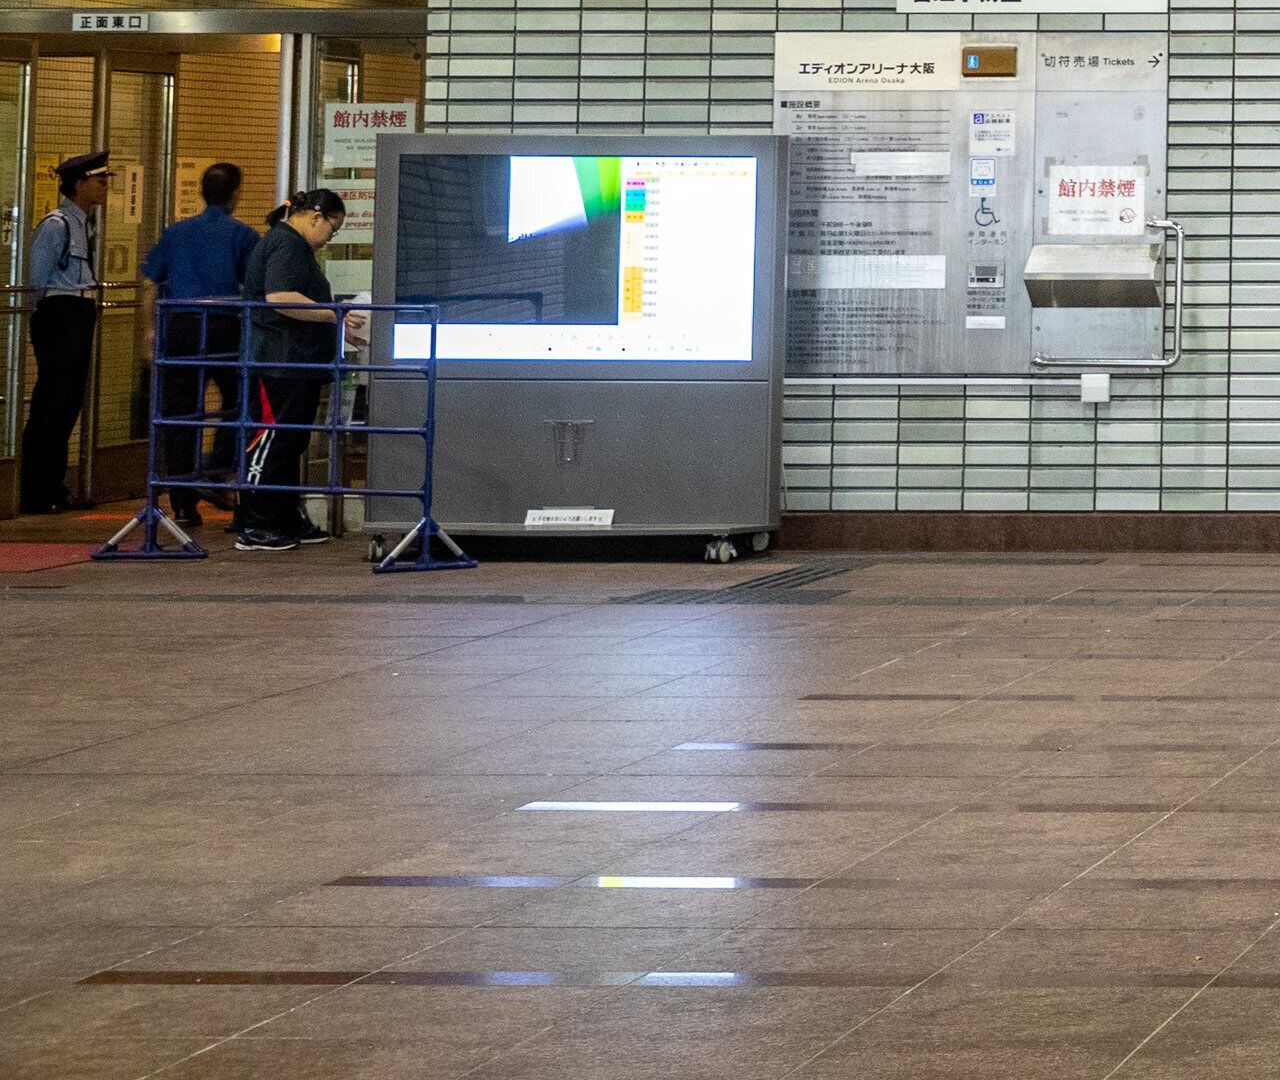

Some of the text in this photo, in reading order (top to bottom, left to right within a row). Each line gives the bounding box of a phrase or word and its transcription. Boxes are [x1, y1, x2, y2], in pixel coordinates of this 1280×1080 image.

[81, 16, 141, 28] 正面東口
[1102, 57, 1134, 65] Tickets
[799, 63, 934, 74] エディオンアリーナ大阪
[333, 110, 407, 128] 館内禁煙
[1059, 180, 1135, 197] 館内禁煙
